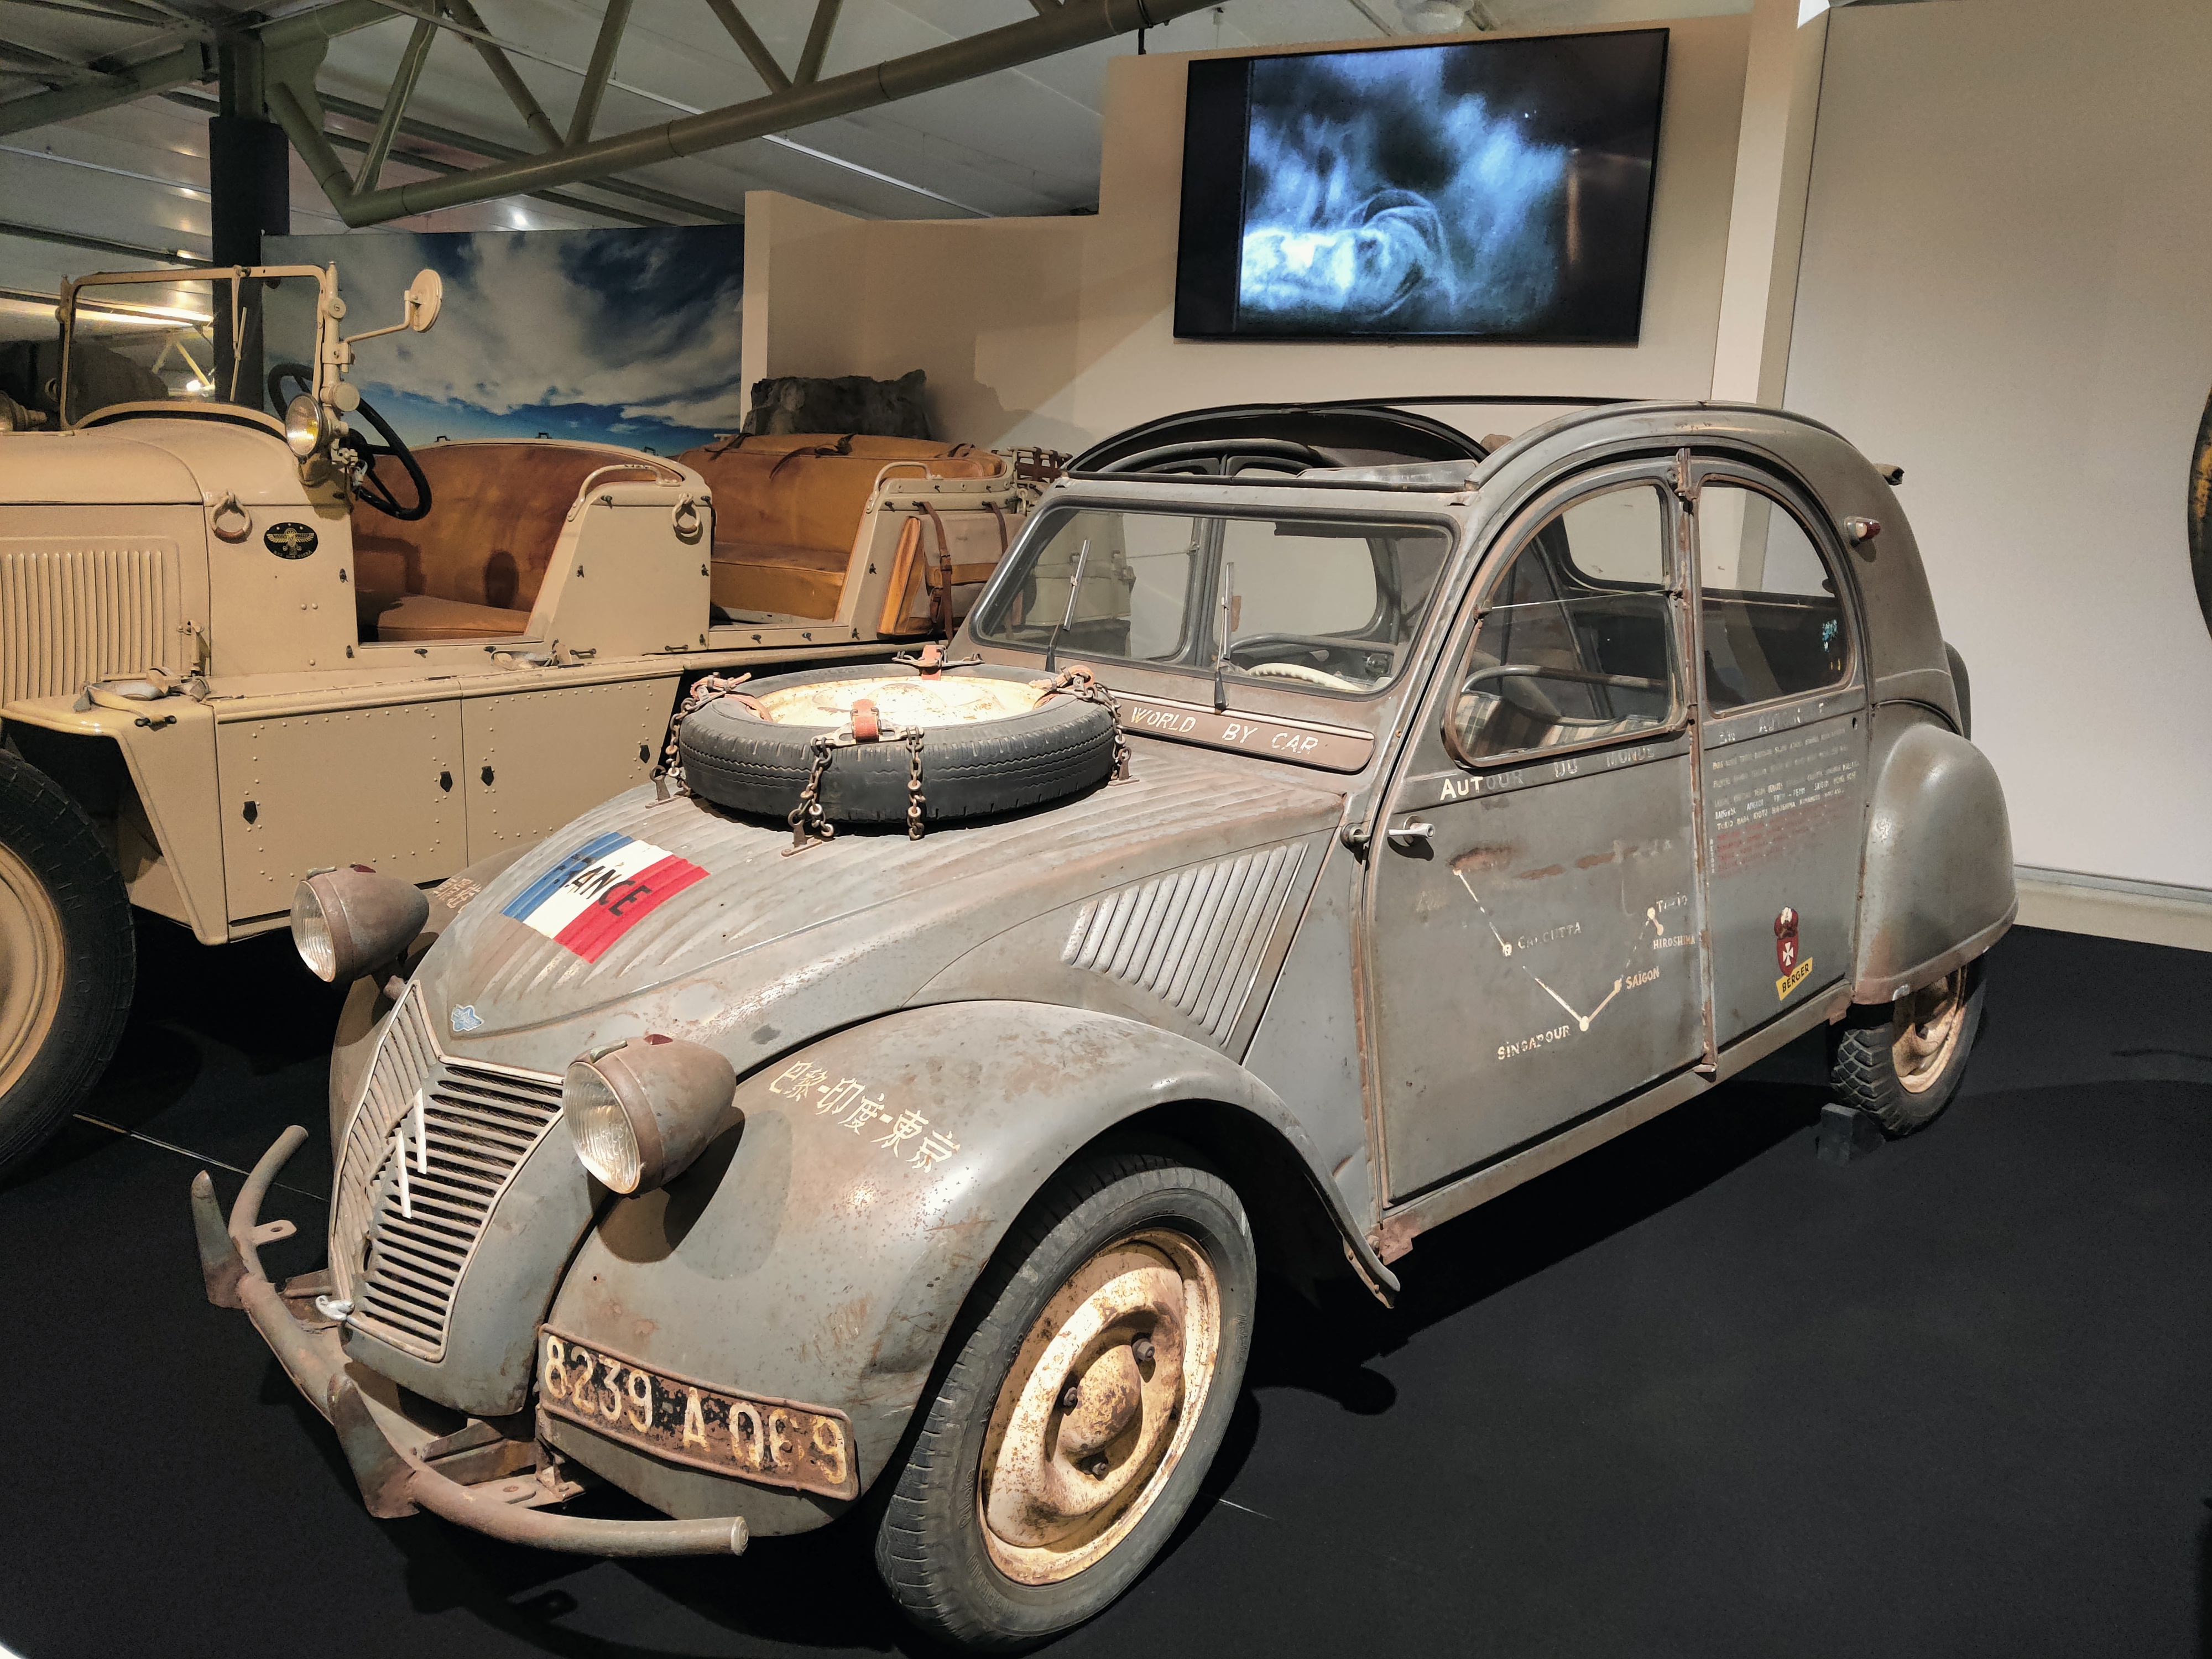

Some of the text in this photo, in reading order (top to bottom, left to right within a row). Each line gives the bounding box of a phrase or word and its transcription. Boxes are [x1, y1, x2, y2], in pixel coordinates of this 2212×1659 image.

[1130, 707, 1319, 755] WORLD BY CAR
[1653, 935, 1695, 950] HIROSHIMA
[1782, 963, 1809, 993] BERGER
[544, 1334, 654, 1433] 8239
